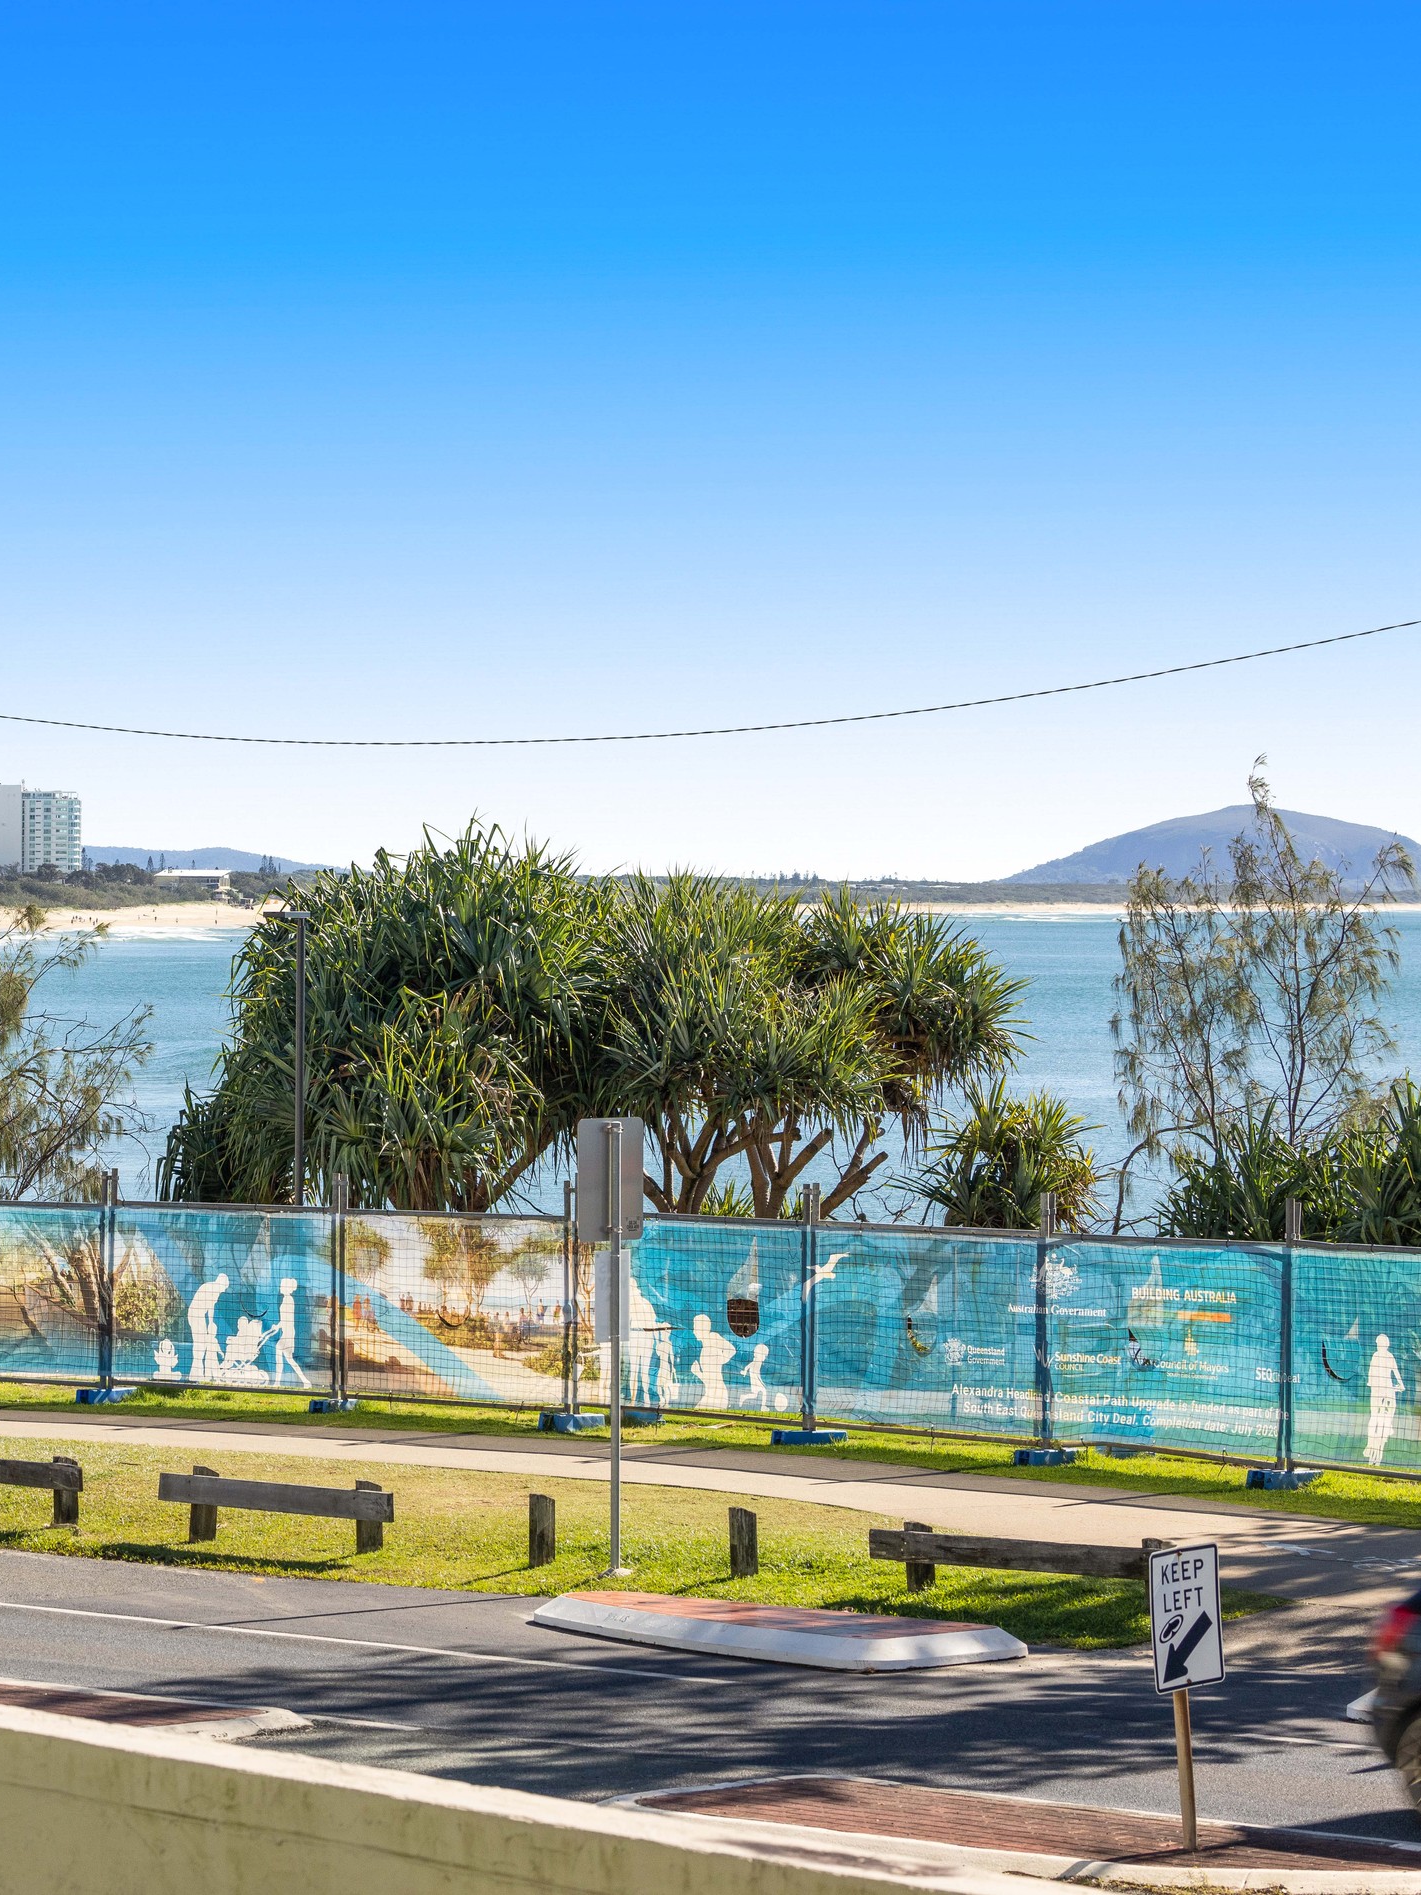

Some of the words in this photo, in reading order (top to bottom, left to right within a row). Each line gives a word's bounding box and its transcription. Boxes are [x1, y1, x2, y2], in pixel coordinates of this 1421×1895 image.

[1131, 1287, 1180, 1300] BUILDING
[1184, 1290, 1237, 1304] AUSTRALIA
[1008, 1303, 1049, 1315] Australian
[1051, 1305, 1107, 1317] Government
[967, 1345, 1005, 1356] Queensland
[1054, 1351, 1095, 1363] Sunshine
[1096, 1353, 1122, 1365] Coast
[967, 1355, 1005, 1365] Government
[1055, 1363, 1085, 1371] COUNCIL
[1155, 1358, 1187, 1370] Council
[1188, 1360, 1198, 1371] of
[1199, 1361, 1229, 1374] Mayors
[951, 1383, 1003, 1398] Alexandra
[1006, 1387, 1051, 1403] Headland
[1054, 1391, 1100, 1405] Coastal
[1102, 1393, 1129, 1407] Path
[1132, 1397, 1175, 1411] Upgrade
[1178, 1400, 1188, 1411] is
[1191, 1400, 1225, 1413] funded
[1228, 1405, 1240, 1414] as
[1242, 1405, 1262, 1419] part
[1264, 1406, 1274, 1417] of
[1275, 1407, 1289, 1420] the
[963, 1401, 993, 1413] South
[996, 1403, 1018, 1416] East
[1020, 1405, 1083, 1422] Queensland
[1087, 1410, 1109, 1426] City
[1112, 1412, 1138, 1426] Deal.
[1142, 1415, 1201, 1431] Completion
[1204, 1419, 1229, 1434] date:
[1231, 1421, 1253, 1437] July
[1161, 1558, 1204, 1585] KEEP
[1163, 1587, 1203, 1613] LEFT
